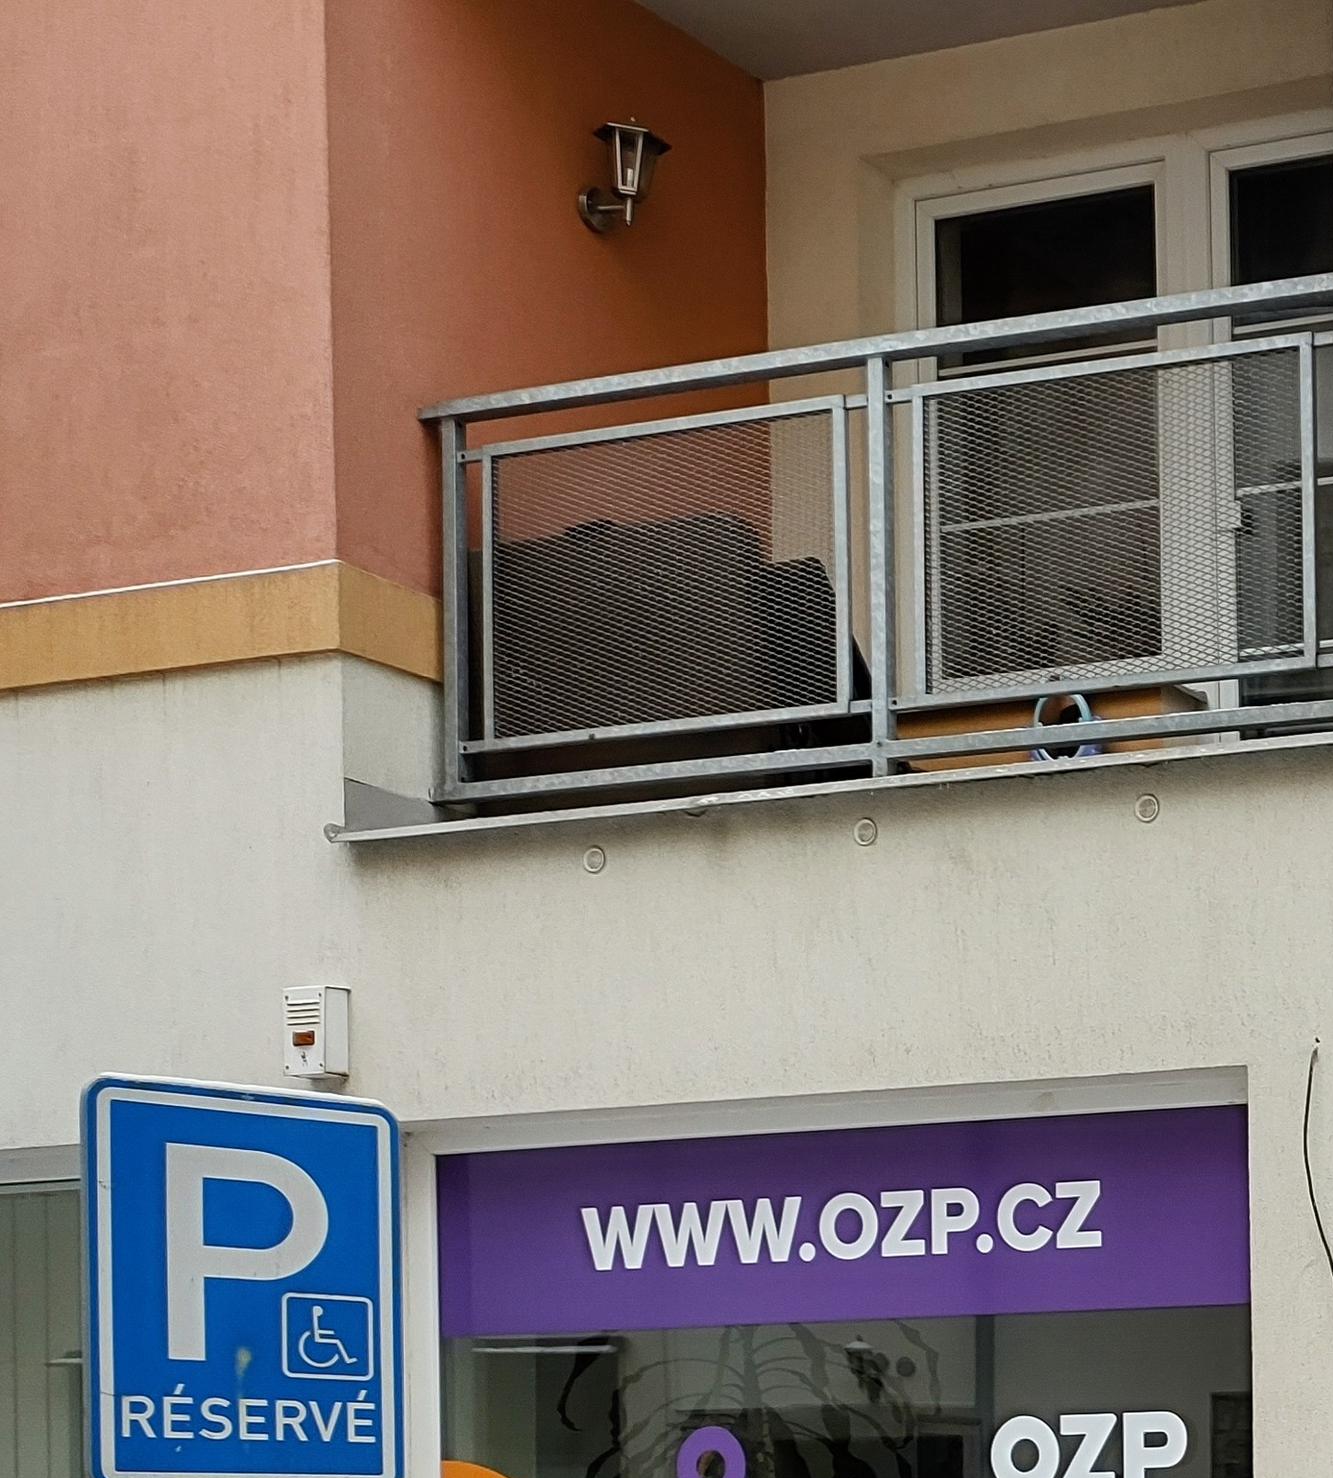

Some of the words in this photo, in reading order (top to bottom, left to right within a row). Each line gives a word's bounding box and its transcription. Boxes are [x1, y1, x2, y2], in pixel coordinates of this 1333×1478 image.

[165, 1142, 329, 1362] P
[580, 1179, 1102, 1271] WWW.OZP.CZ
[121, 1383, 377, 1445] RÉSERVÉ
